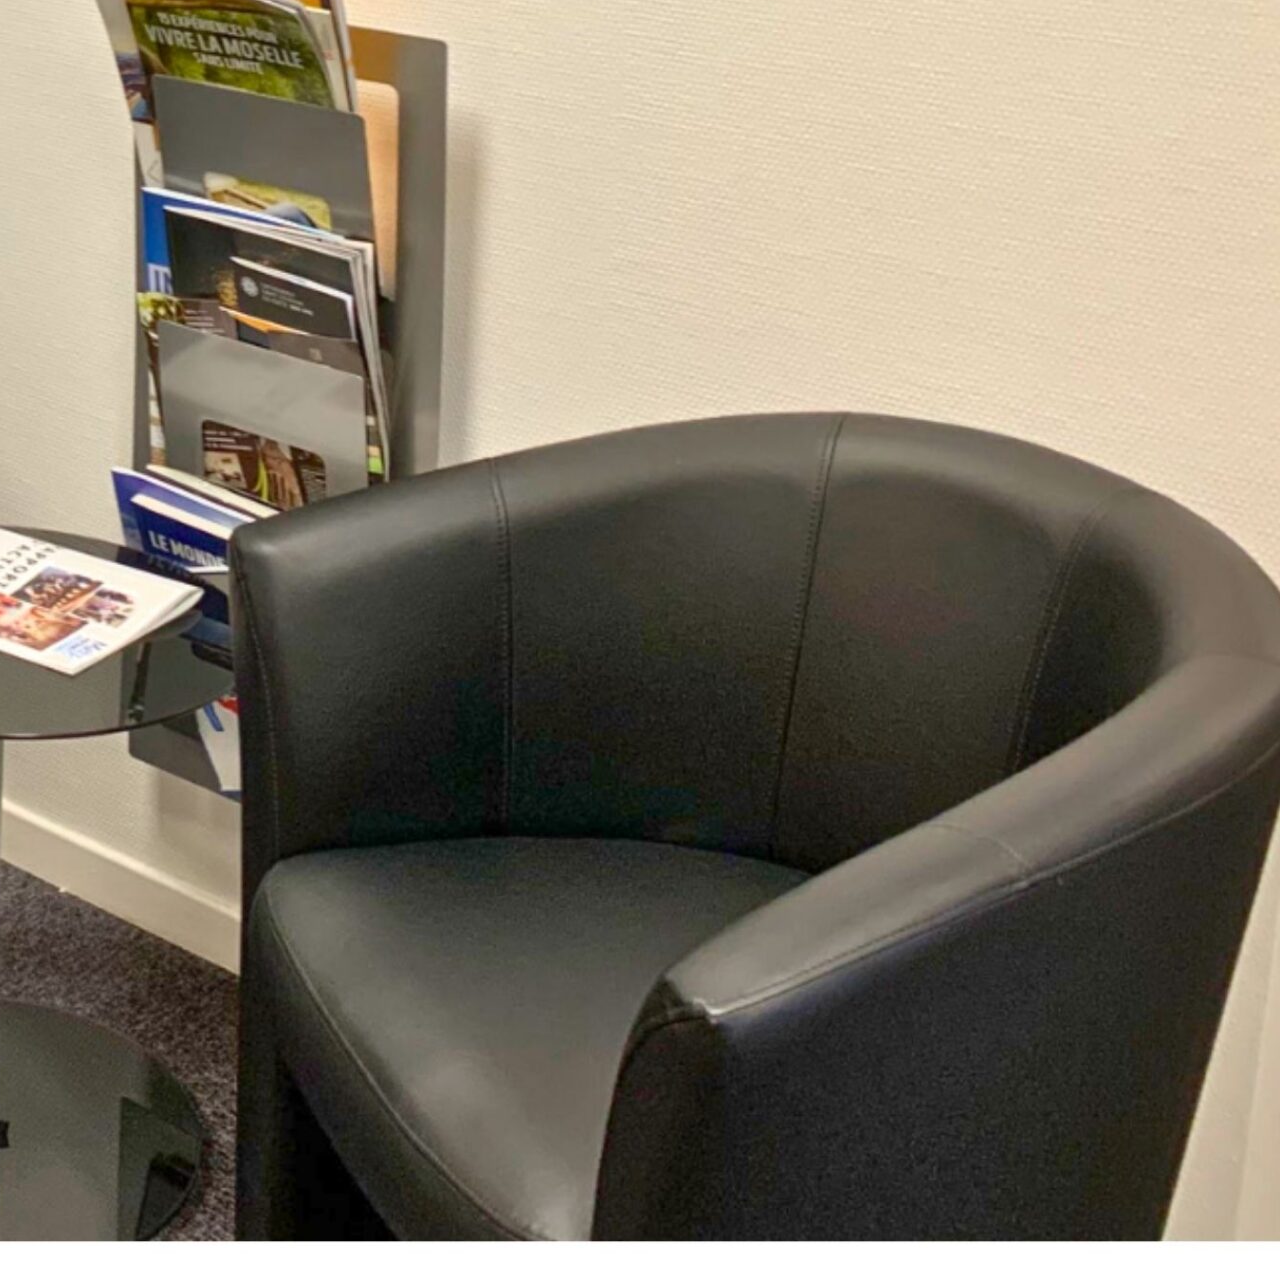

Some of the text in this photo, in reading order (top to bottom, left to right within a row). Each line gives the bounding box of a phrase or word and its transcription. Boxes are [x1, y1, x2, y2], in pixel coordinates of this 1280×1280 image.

[145, 24, 305, 69] VIVRE LA MOSELLE
[148, 530, 170, 553] LE
